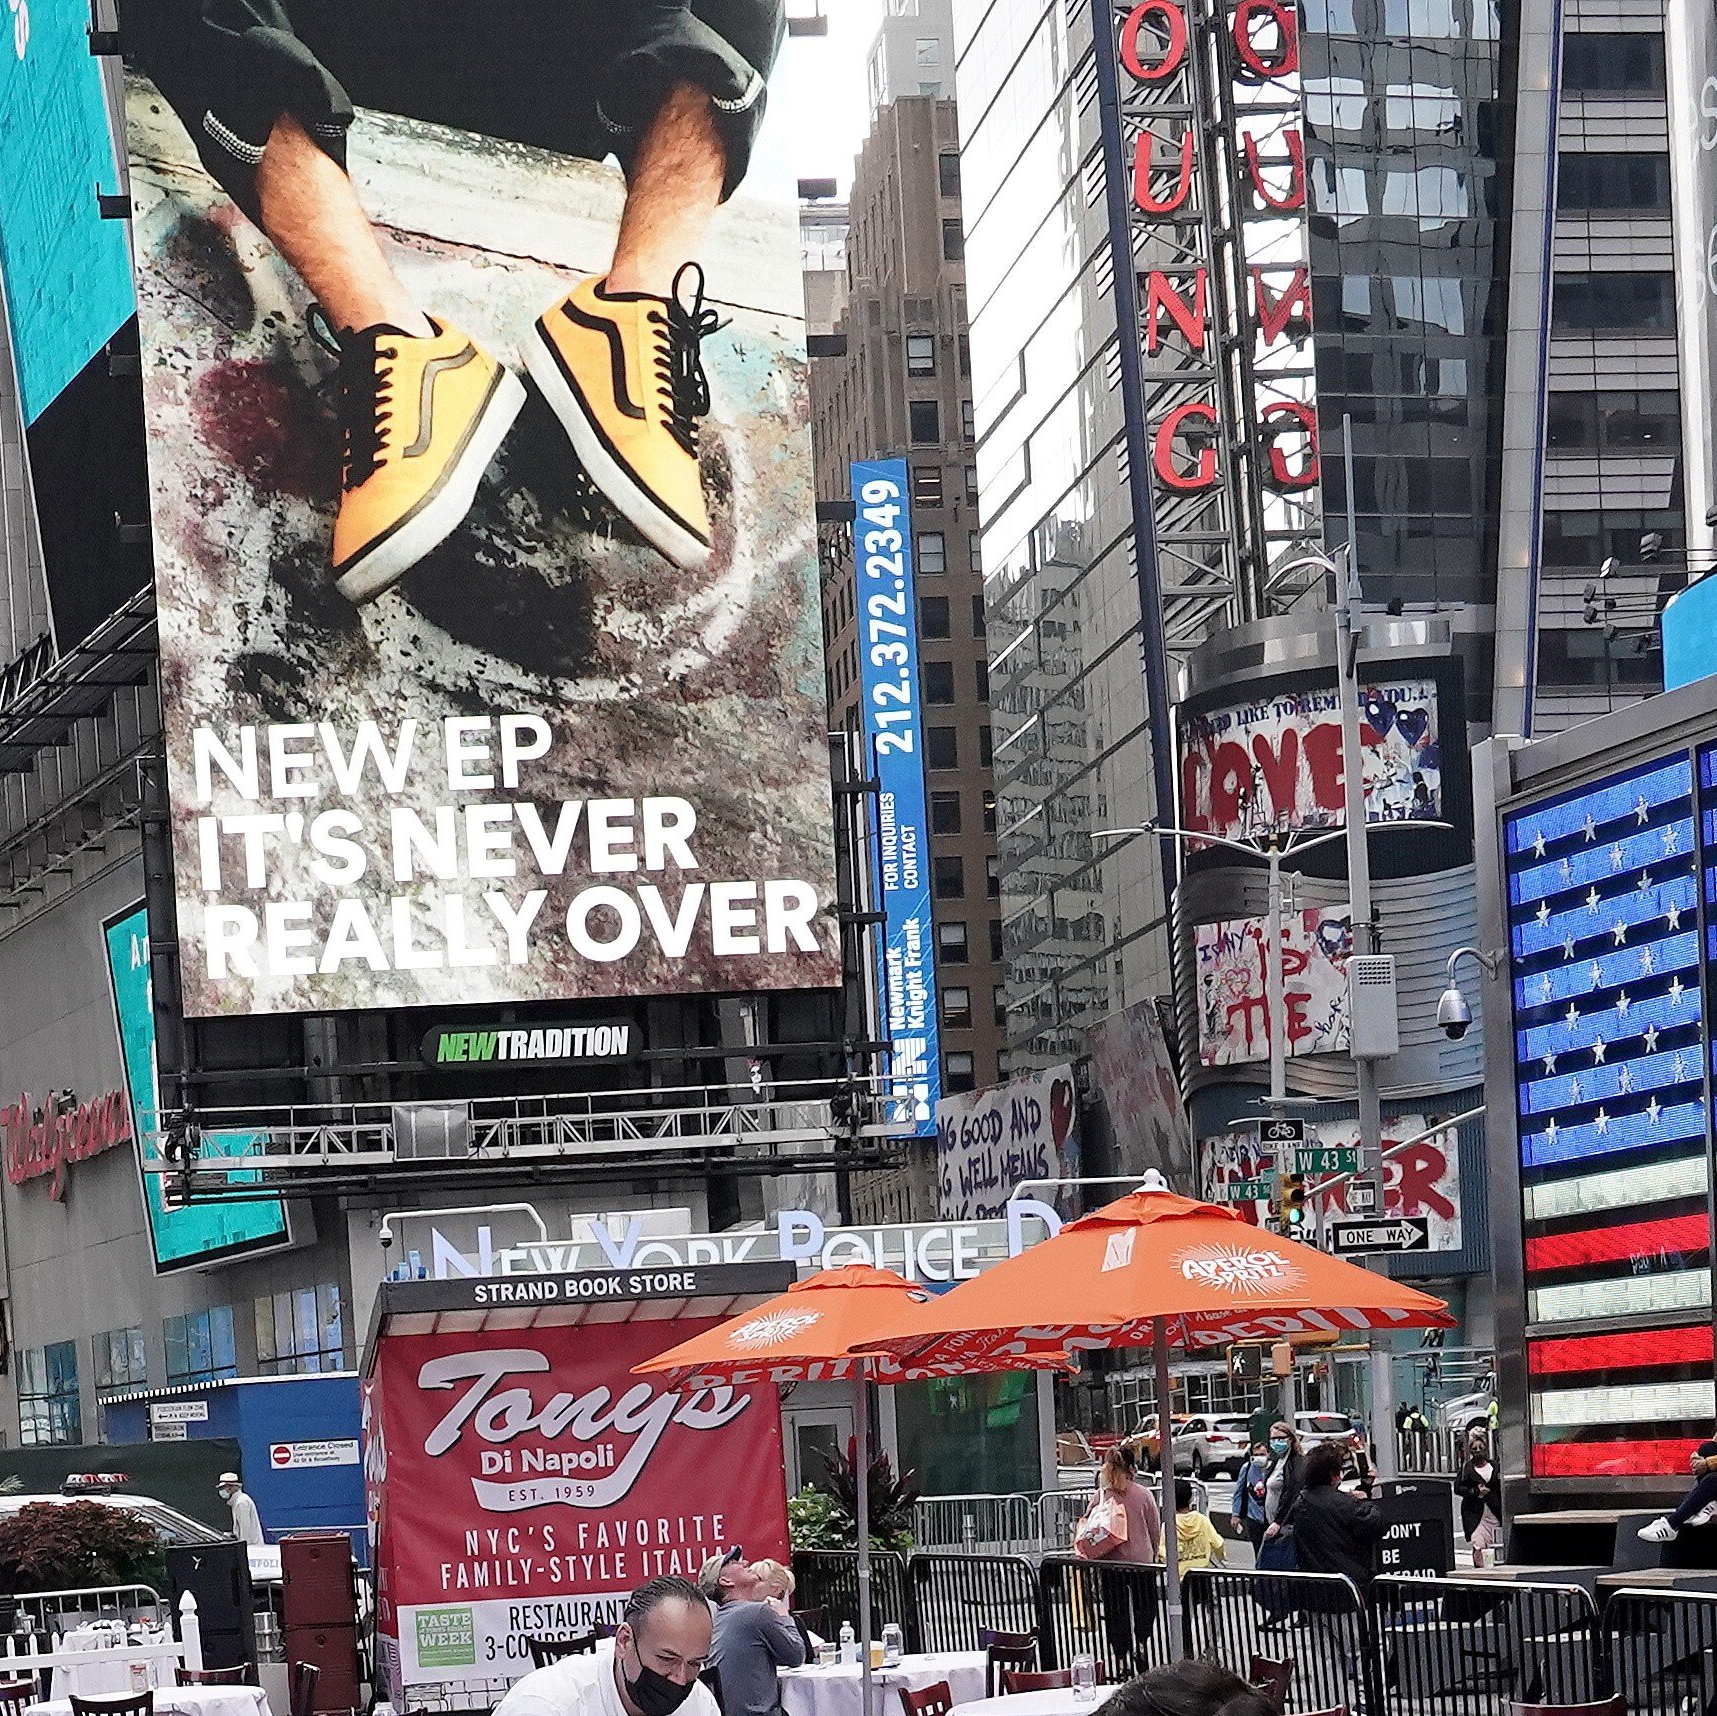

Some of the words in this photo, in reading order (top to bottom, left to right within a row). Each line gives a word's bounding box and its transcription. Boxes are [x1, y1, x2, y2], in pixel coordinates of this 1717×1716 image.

[861, 479, 914, 756] 212.372.2349
[193, 718, 418, 802] NEW
[444, 714, 552, 791] EP
[198, 808, 368, 891] IT'S
[391, 796, 698, 882] NEVER
[882, 792, 898, 855] INQUIRIES
[884, 857, 900, 892] FOR
[901, 824, 919, 890] CONTACT
[204, 888, 550, 980] REALLY
[566, 879, 822, 963] OVER
[905, 919, 921, 965] Frank
[887, 947, 905, 1030] Newmark
[906, 968, 926, 1028] Knight
[960, 1108, 1003, 1150] GOOD
[1010, 1095, 1042, 1147] AND
[1299, 1153, 1314, 1170] W
[1320, 1151, 1340, 1170] 43
[1229, 1186, 1241, 1199] W
[1244, 1186, 1259, 1198] 43
[430, 1225, 582, 1280] NEW
[778, 1209, 982, 1281] POLICE
[1346, 1230, 1375, 1244] ONE
[1386, 1228, 1415, 1242] WAY
[1182, 1250, 1290, 1280] APEROL
[1208, 1264, 1285, 1288] SPRITZ
[474, 1282, 559, 1303] STRAND
[565, 1276, 623, 1298] BOOK
[627, 1272, 696, 1295] STORE
[293, 1443, 325, 1451] Entrance
[328, 1441, 354, 1449] Closed
[418, 1349, 751, 1511] Tonys
[481, 1451, 513, 1474] Di
[521, 1444, 614, 1475] Napoli
[508, 1487, 545, 1503] EST.
[555, 1485, 595, 1499] 1959
[465, 1525, 556, 1557] NYC'S
[578, 1514, 725, 1550] FAVORITE
[441, 1553, 626, 1591] FAMILY-STYLE
[417, 1612, 472, 1629] TASTE
[419, 1630, 473, 1647] WEEK
